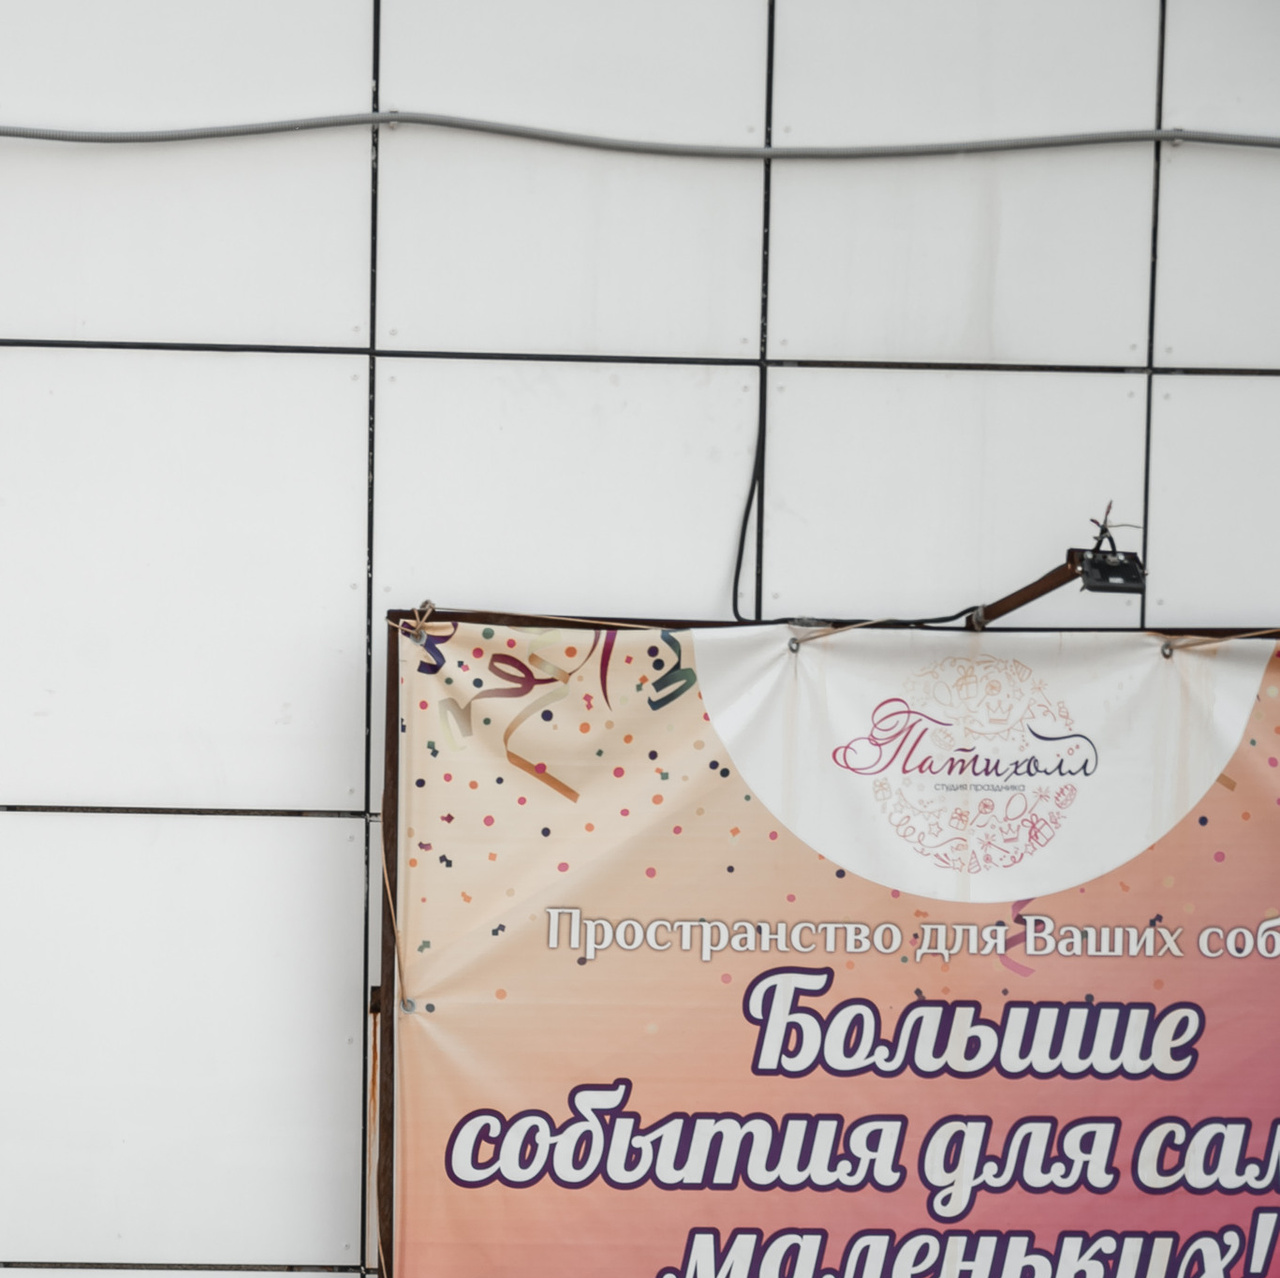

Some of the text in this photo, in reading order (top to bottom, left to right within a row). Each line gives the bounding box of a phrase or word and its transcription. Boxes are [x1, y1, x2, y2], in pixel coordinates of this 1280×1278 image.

[832, 698, 1098, 782] Патихолл
[547, 908, 902, 961] Пространство
[916, 922, 1008, 962] для
[1024, 915, 1184, 957] Ваших
[744, 966, 1206, 1080] Большие
[446, 1078, 907, 1190] события
[920, 1114, 1122, 1218] для
